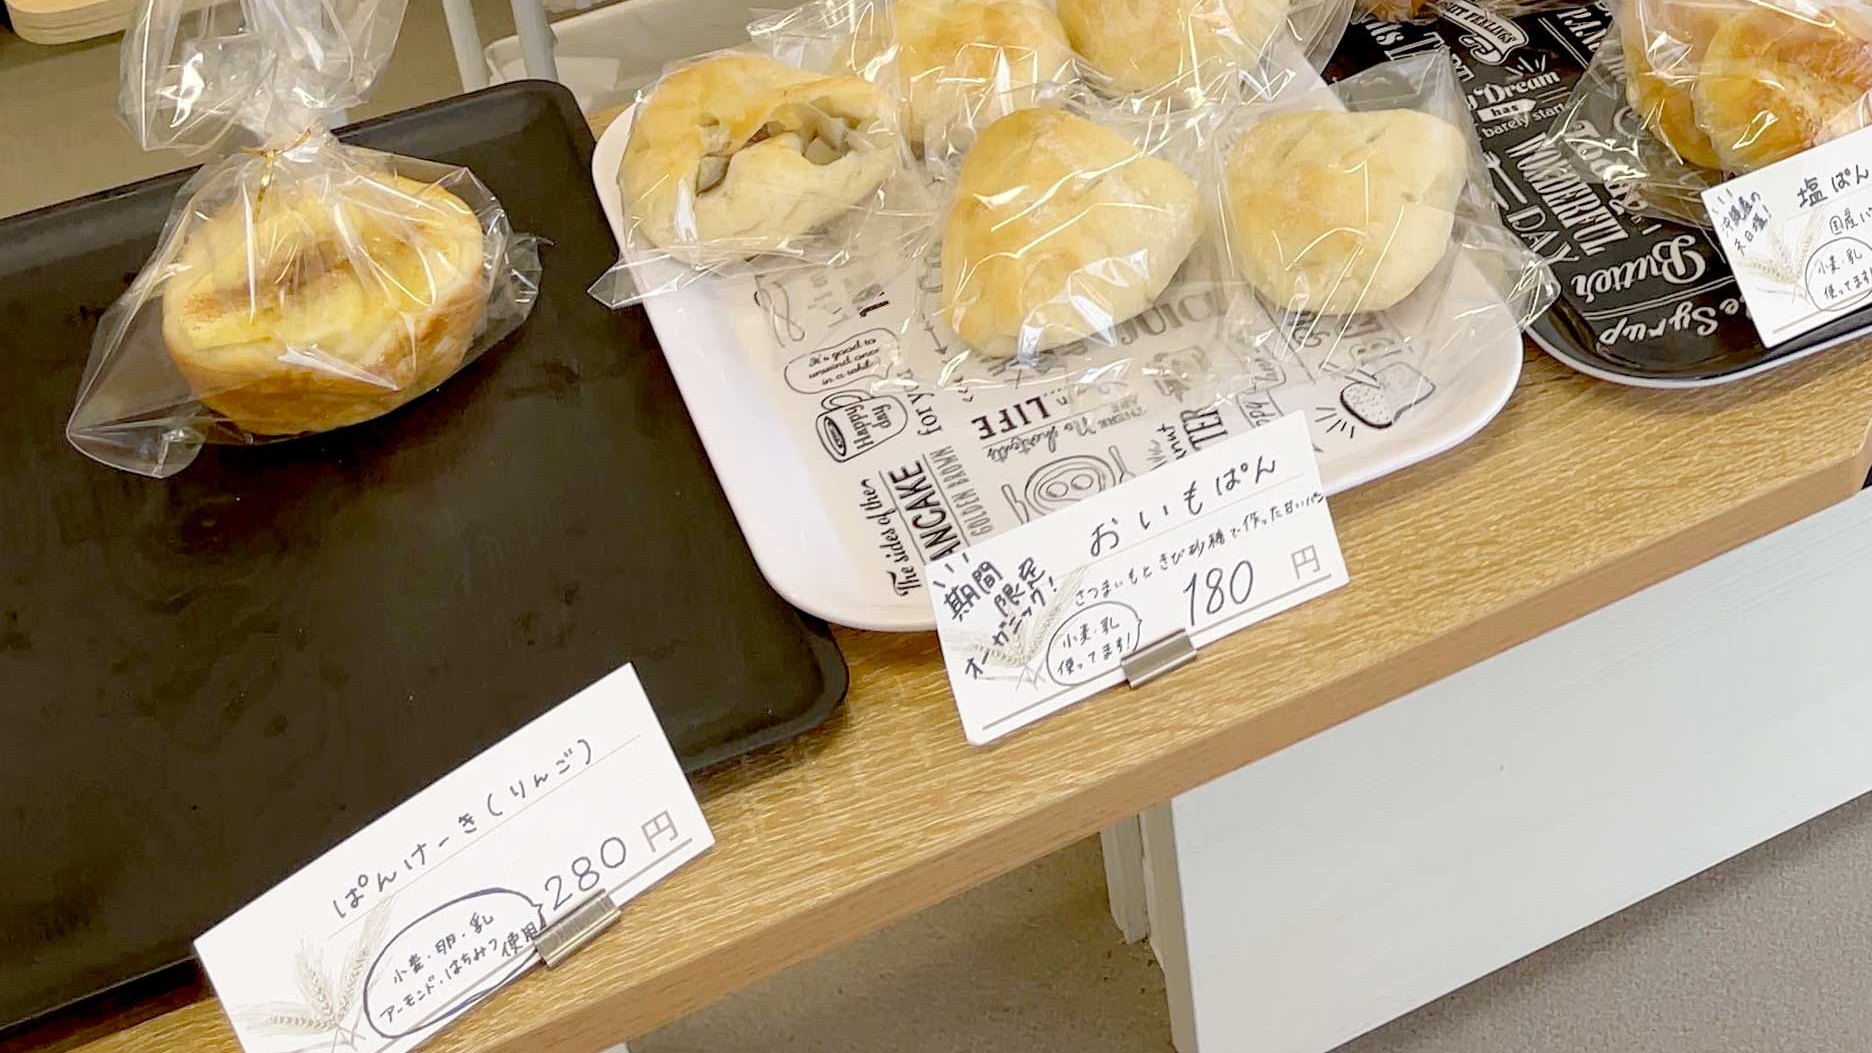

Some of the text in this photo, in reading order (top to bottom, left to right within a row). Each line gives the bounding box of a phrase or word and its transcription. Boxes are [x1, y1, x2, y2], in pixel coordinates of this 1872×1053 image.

[1473, 70, 1561, 106] Dream
[1481, 113, 1530, 139] barely
[1505, 131, 1630, 257] WONDERFUL
[1507, 205, 1581, 265] DAY
[1570, 233, 1707, 303] Butter
[1598, 300, 1720, 353] Syrup
[844, 403, 875, 450] Happy
[871, 403, 893, 429] day
[915, 406, 943, 437] for
[971, 396, 1051, 441] LIFE
[888, 459, 965, 565] ANCAKE
[929, 443, 996, 538] GOLDEN BROWN
[1089, 455, 1276, 557] おいもぱん
[878, 527, 912, 569] sides
[943, 561, 1003, 623] 期間
[993, 556, 1047, 618] 限定
[1183, 545, 1322, 626] 180 円
[544, 809, 680, 912] 280 円
